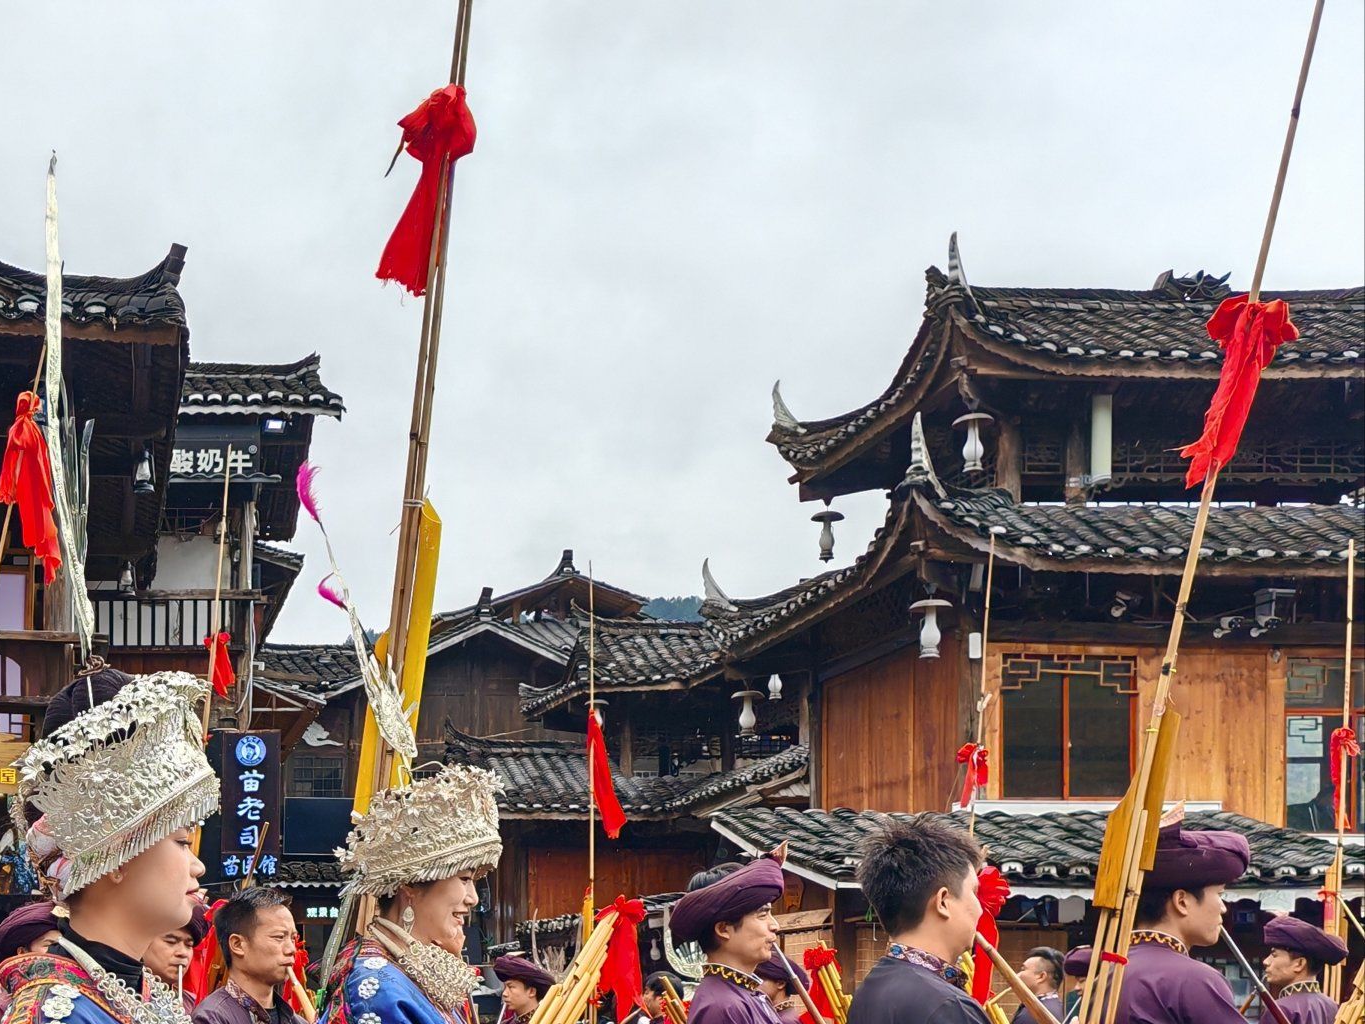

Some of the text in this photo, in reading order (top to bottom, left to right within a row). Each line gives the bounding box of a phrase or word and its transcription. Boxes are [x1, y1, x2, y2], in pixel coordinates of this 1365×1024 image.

[170, 449, 253, 474] 酸奶牛
[236, 769, 265, 848] 苗老司
[222, 854, 278, 876] 苗医馆
[306, 906, 340, 918] 观景台
